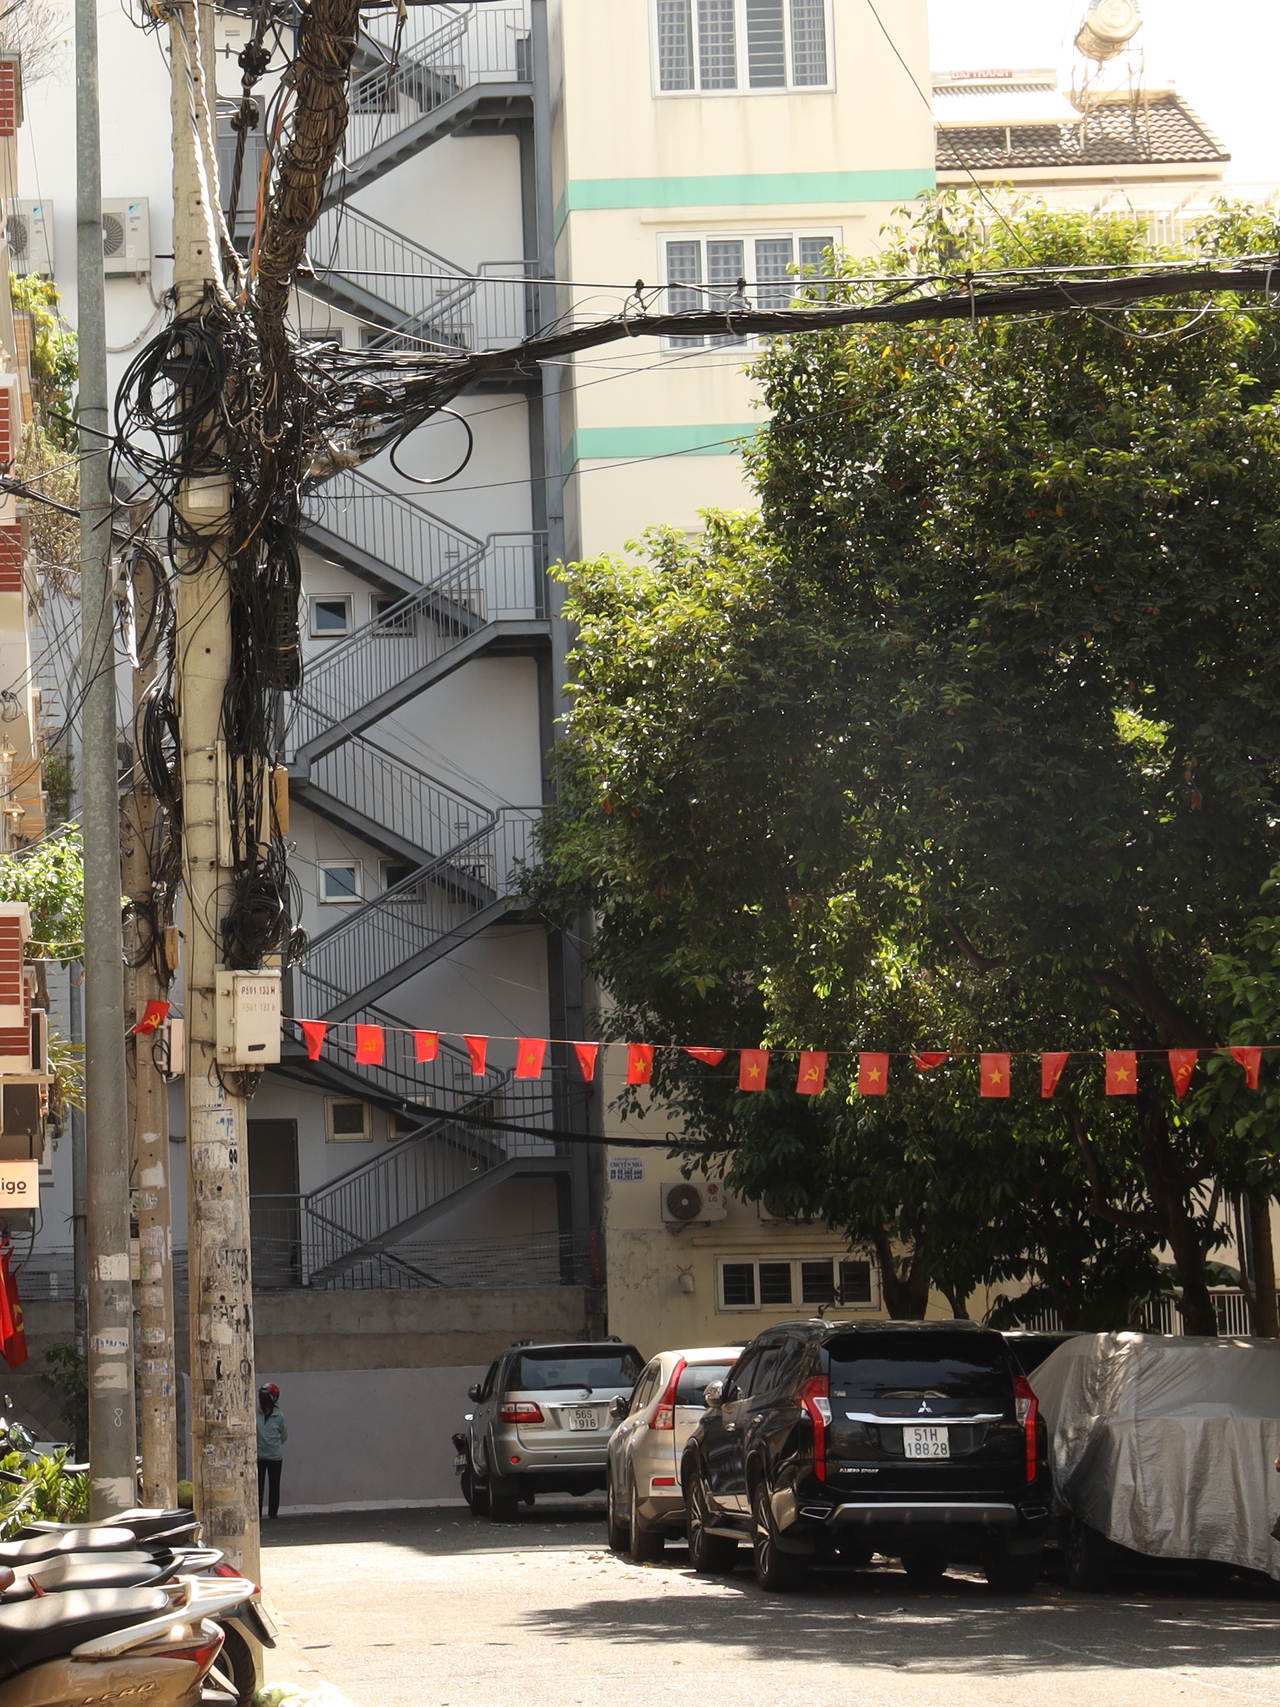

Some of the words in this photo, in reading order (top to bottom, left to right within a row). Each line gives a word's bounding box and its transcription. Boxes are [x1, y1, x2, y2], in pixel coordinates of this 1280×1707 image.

[575, 1409, 593, 1420] 56S
[573, 1419, 596, 1429] 1916
[913, 1428, 938, 1442] 51H
[907, 1442, 948, 1456] 188.28
[82, 1681, 156, 1705] LEAD
